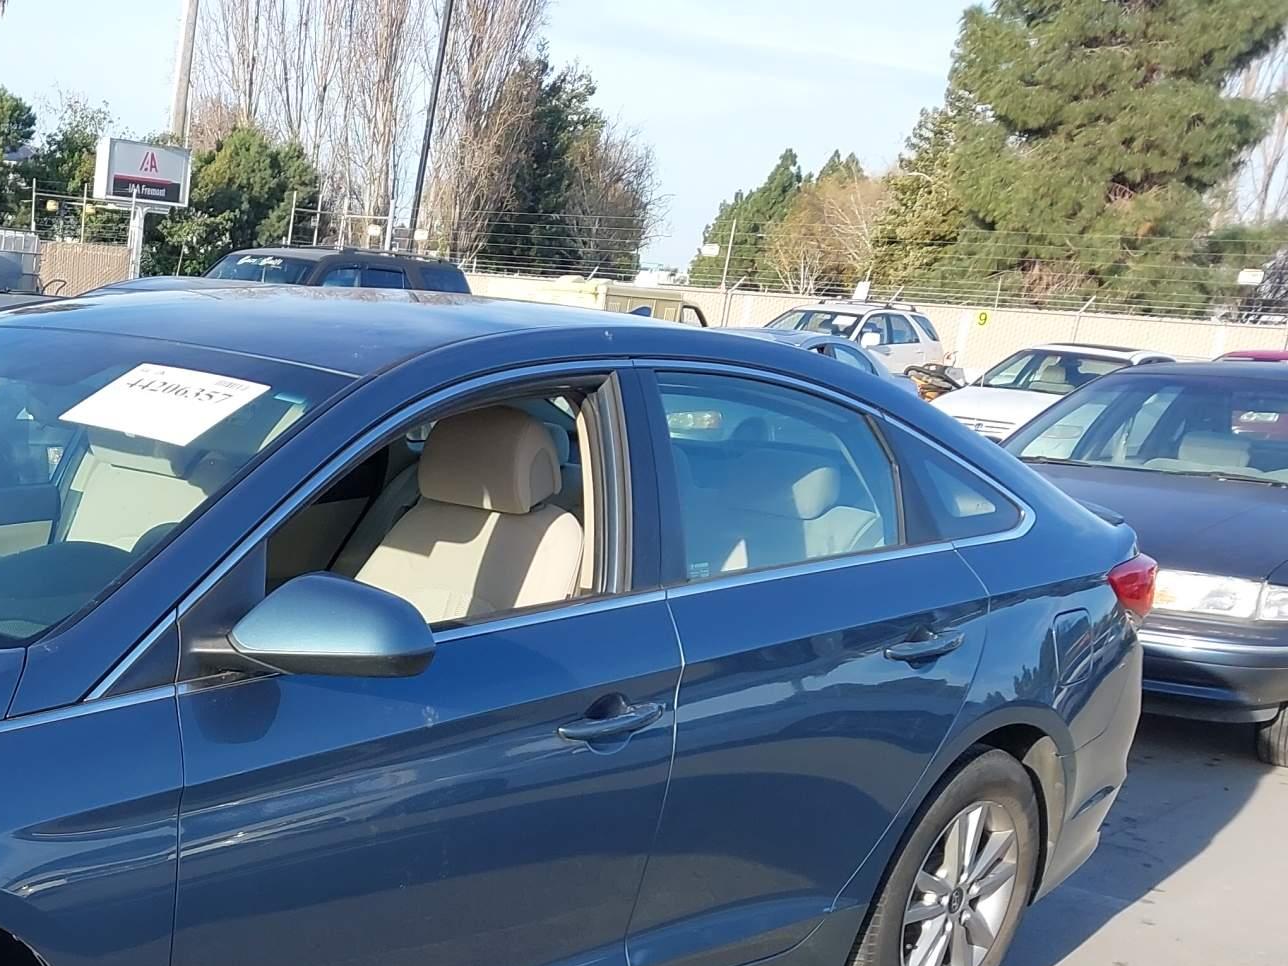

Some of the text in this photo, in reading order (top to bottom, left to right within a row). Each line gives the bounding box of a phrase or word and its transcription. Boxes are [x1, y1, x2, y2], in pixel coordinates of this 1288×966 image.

[128, 182, 166, 197] IAA Fremont
[978, 312, 987, 326] 9
[126, 377, 233, 404] 44206357
